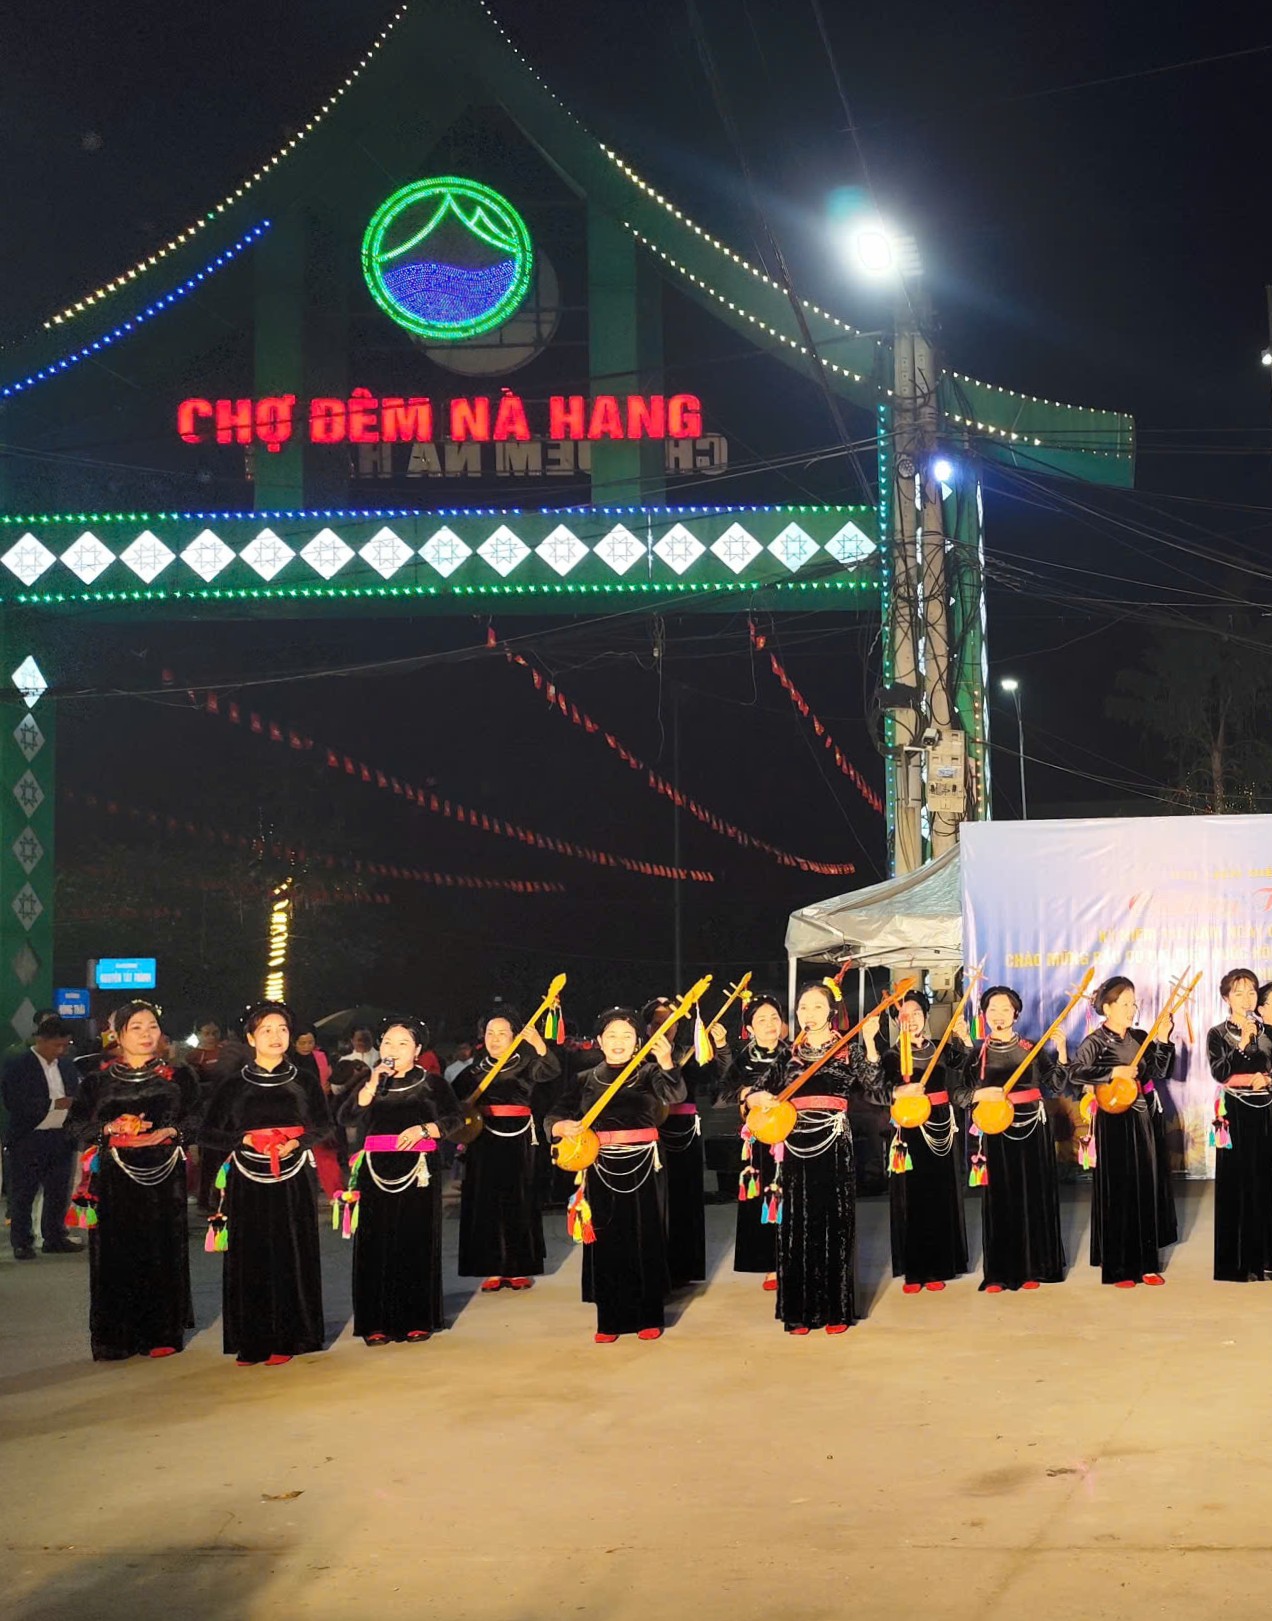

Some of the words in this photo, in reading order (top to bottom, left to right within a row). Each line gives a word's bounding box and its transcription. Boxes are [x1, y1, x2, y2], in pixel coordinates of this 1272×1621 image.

[176, 393, 296, 453] CHỢ
[450, 387, 531, 441] NÀ
[549, 393, 702, 440] HANG
